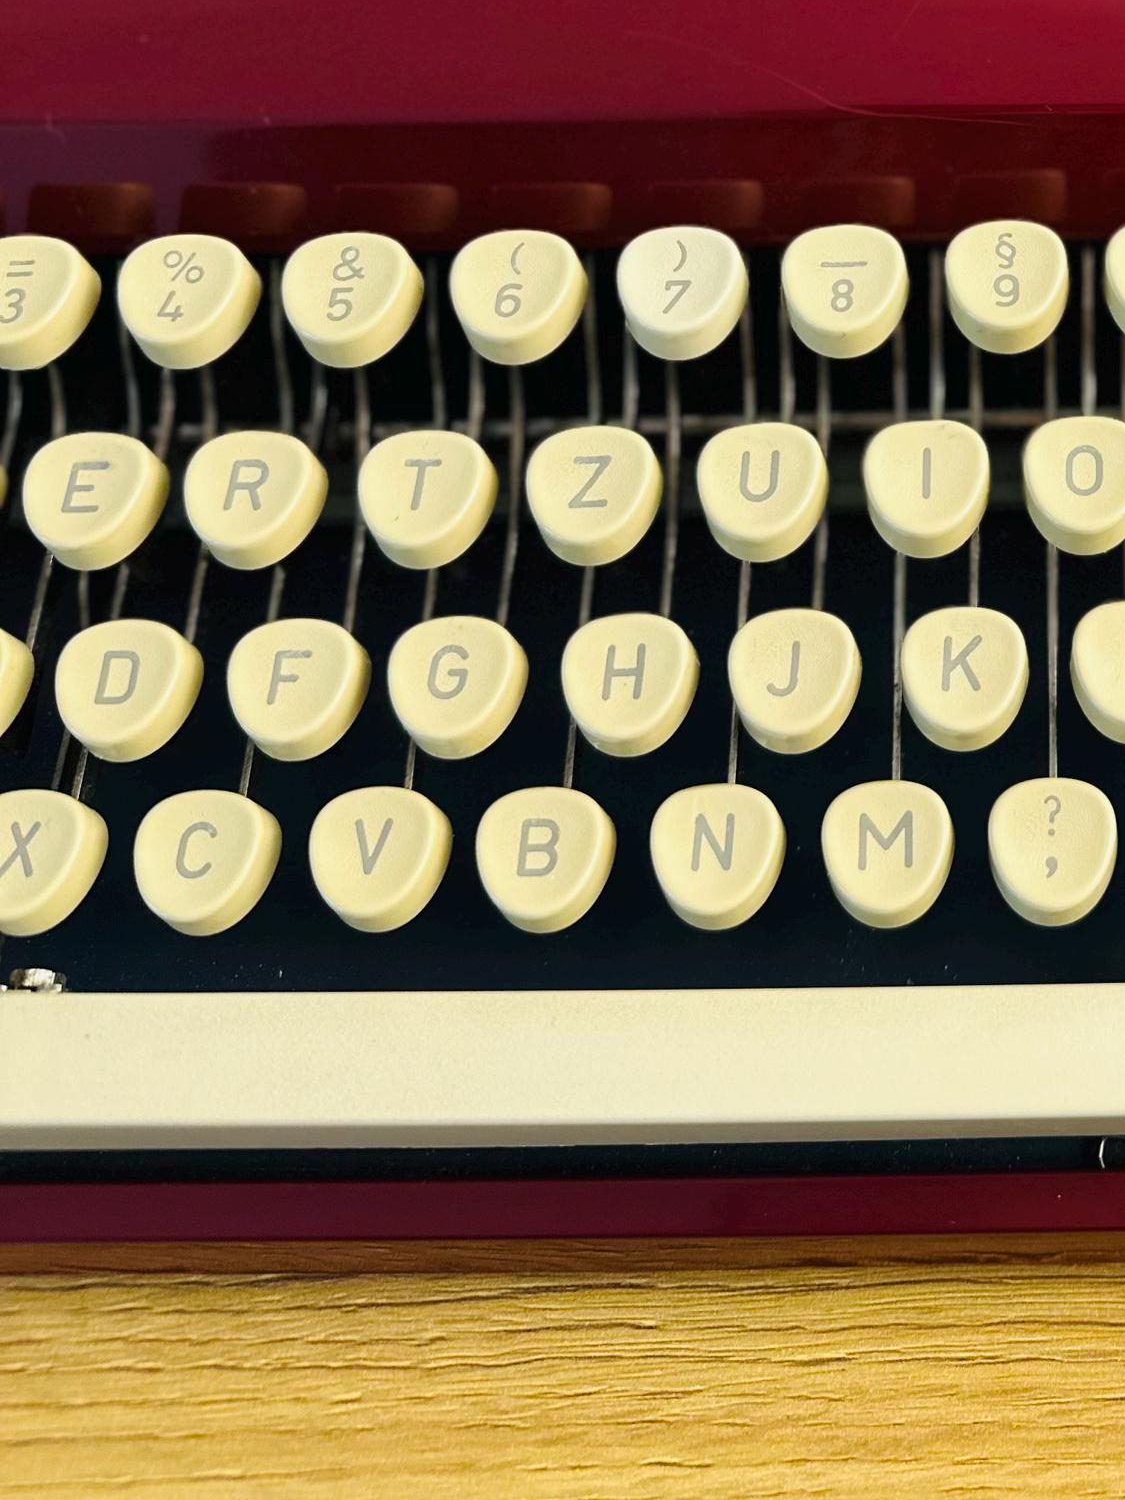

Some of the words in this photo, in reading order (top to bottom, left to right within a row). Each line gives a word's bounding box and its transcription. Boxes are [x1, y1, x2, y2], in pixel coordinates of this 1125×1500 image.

[0, 288, 26, 324] 3
[156, 290, 184, 323] 4
[326, 286, 354, 322] 5
[494, 283, 523, 318] 6
[662, 279, 692, 315] 7
[830, 278, 855, 313] 8
[993, 274, 1020, 308] 9
[60, 460, 111, 513] E
[223, 459, 270, 512] R
[404, 458, 443, 511] T
[567, 455, 612, 509] Z
[739, 449, 780, 503] U
[921, 447, 932, 500] I
[1065, 444, 1104, 497] O
[94, 650, 140, 705] D
[266, 650, 313, 706] F
[427, 644, 470, 700] G
[601, 643, 646, 701] H
[766, 640, 801, 698] J
[941, 634, 983, 692] K
[0, 821, 42, 878] X
[175, 821, 218, 879] C
[354, 817, 394, 876] V
[516, 818, 560, 877] B
[691, 812, 735, 872] N
[857, 809, 914, 871] M
